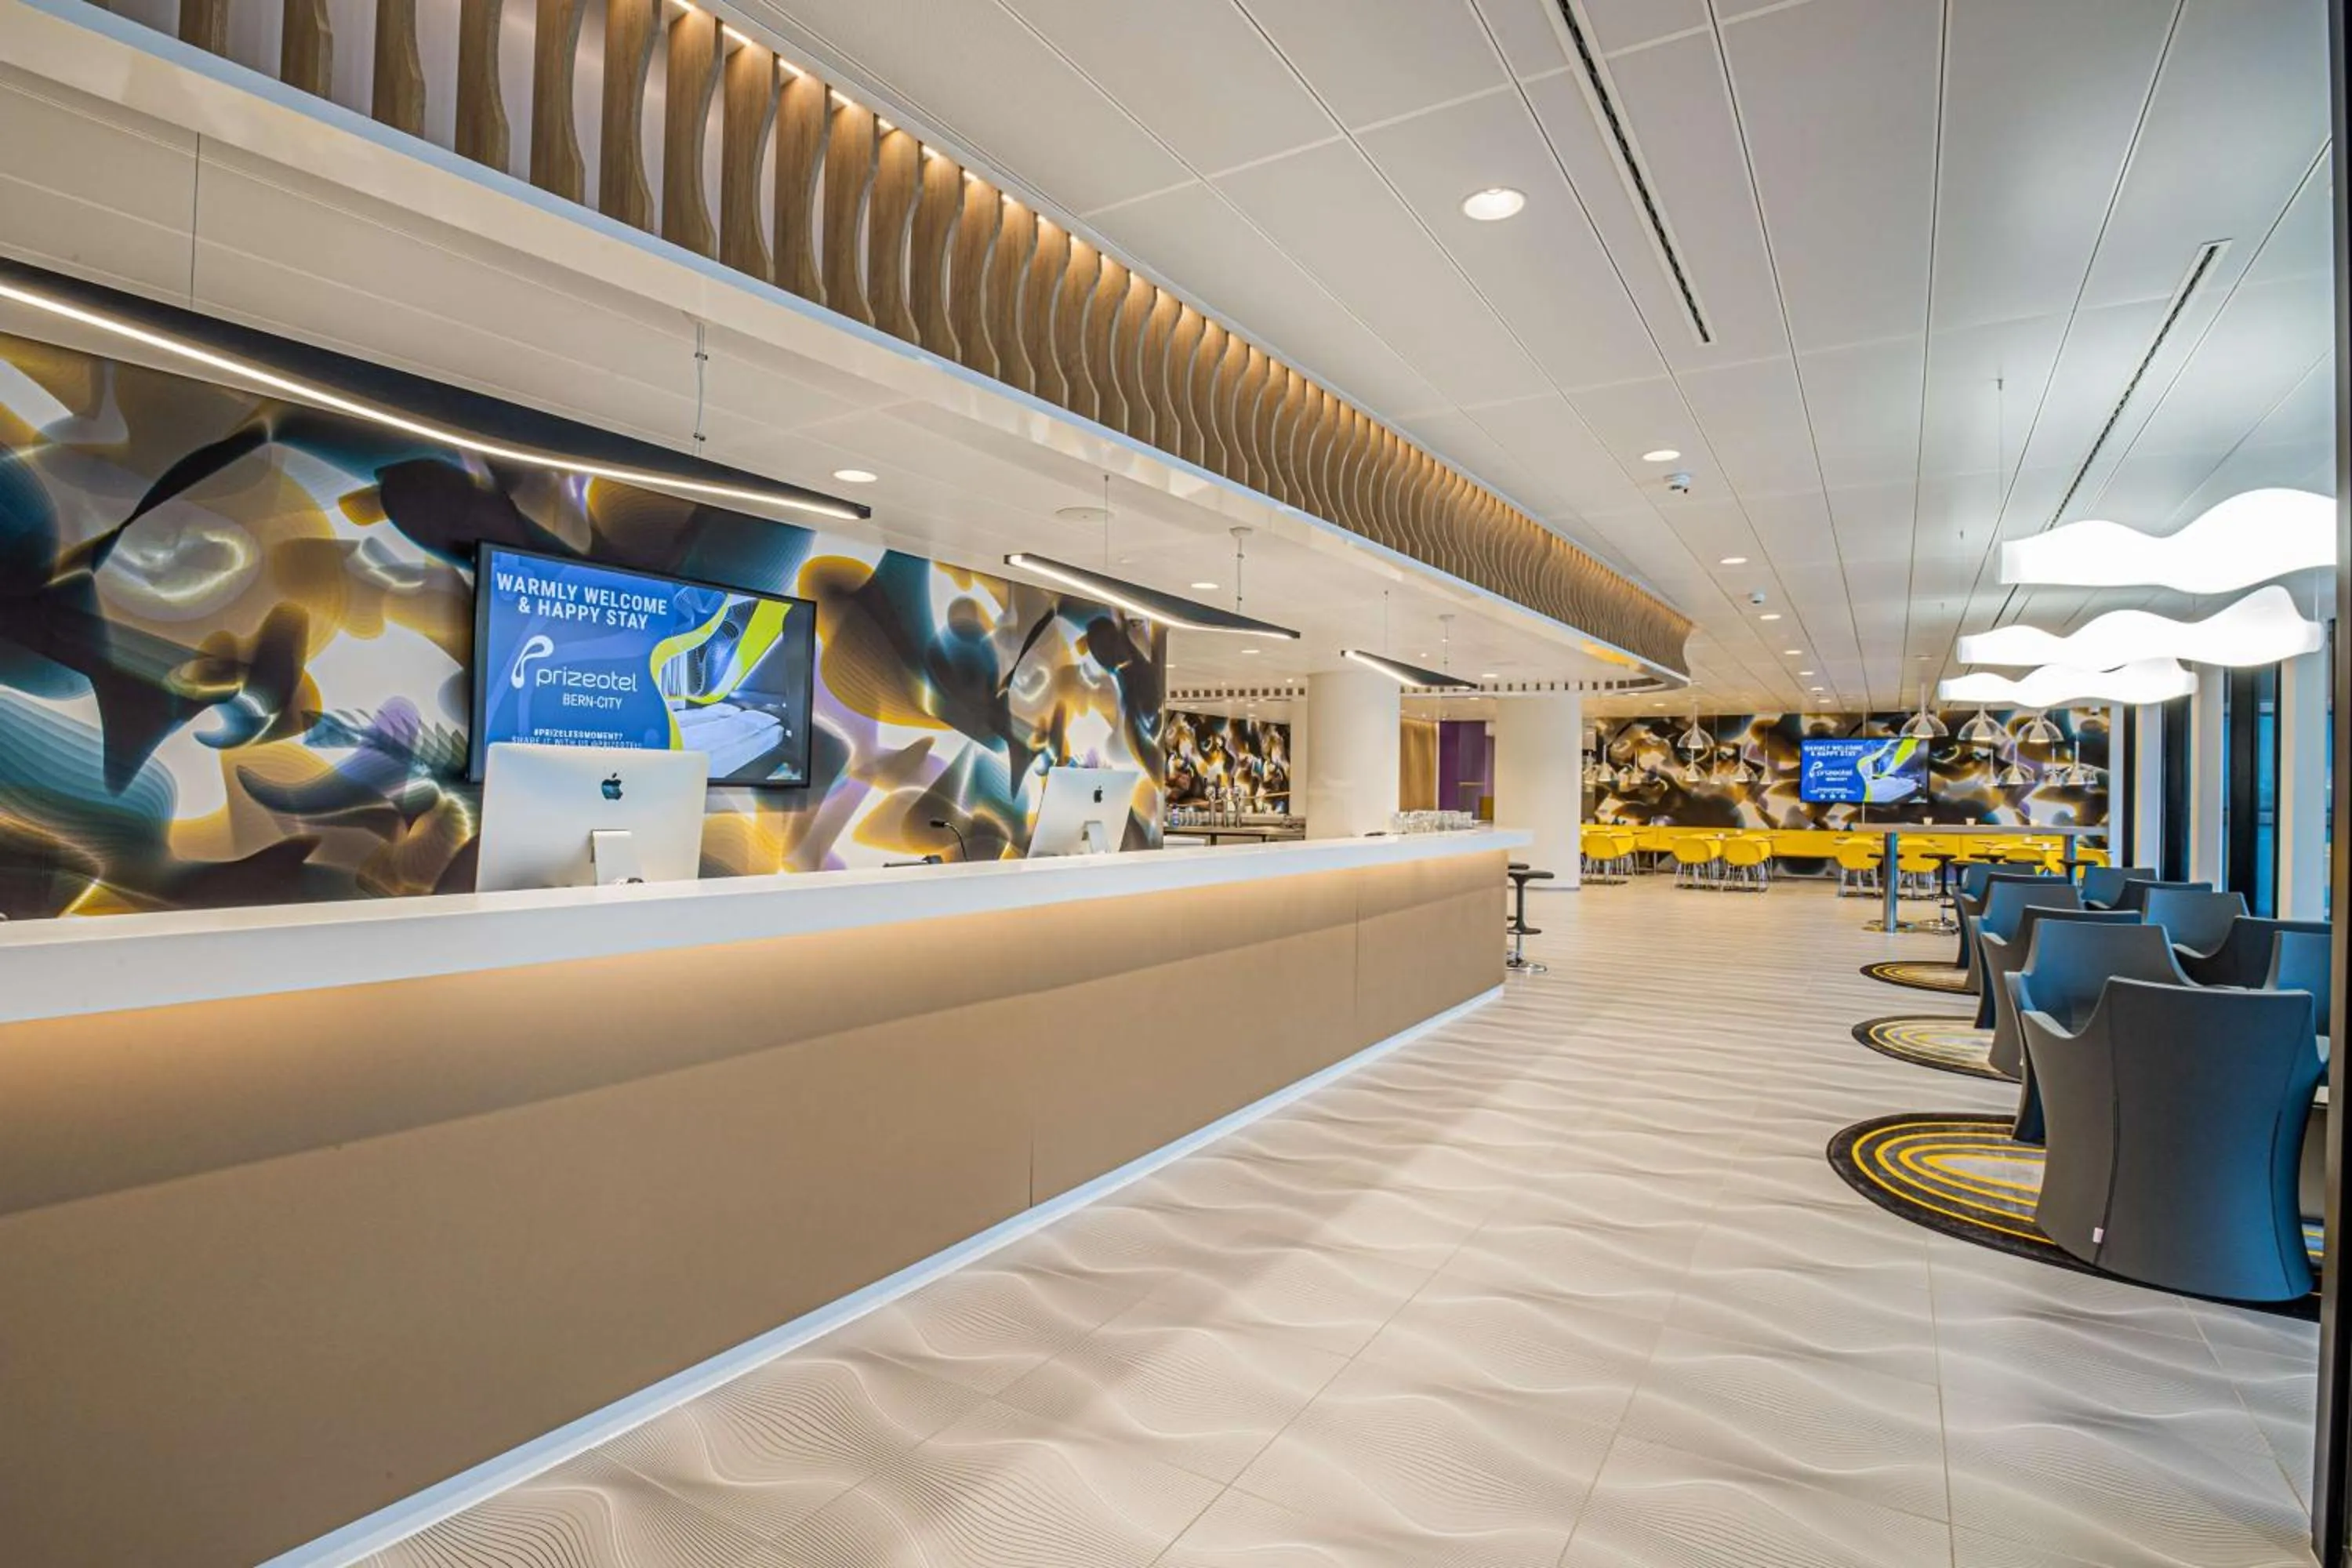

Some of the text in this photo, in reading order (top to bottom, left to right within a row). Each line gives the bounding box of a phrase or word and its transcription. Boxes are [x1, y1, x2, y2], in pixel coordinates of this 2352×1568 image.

[496, 572, 667, 615] WARMLY WELCOME
[518, 596, 649, 630] & HAPPY STAY
[535, 666, 638, 692] prizeotel
[562, 692, 623, 710] BERN-CITY
